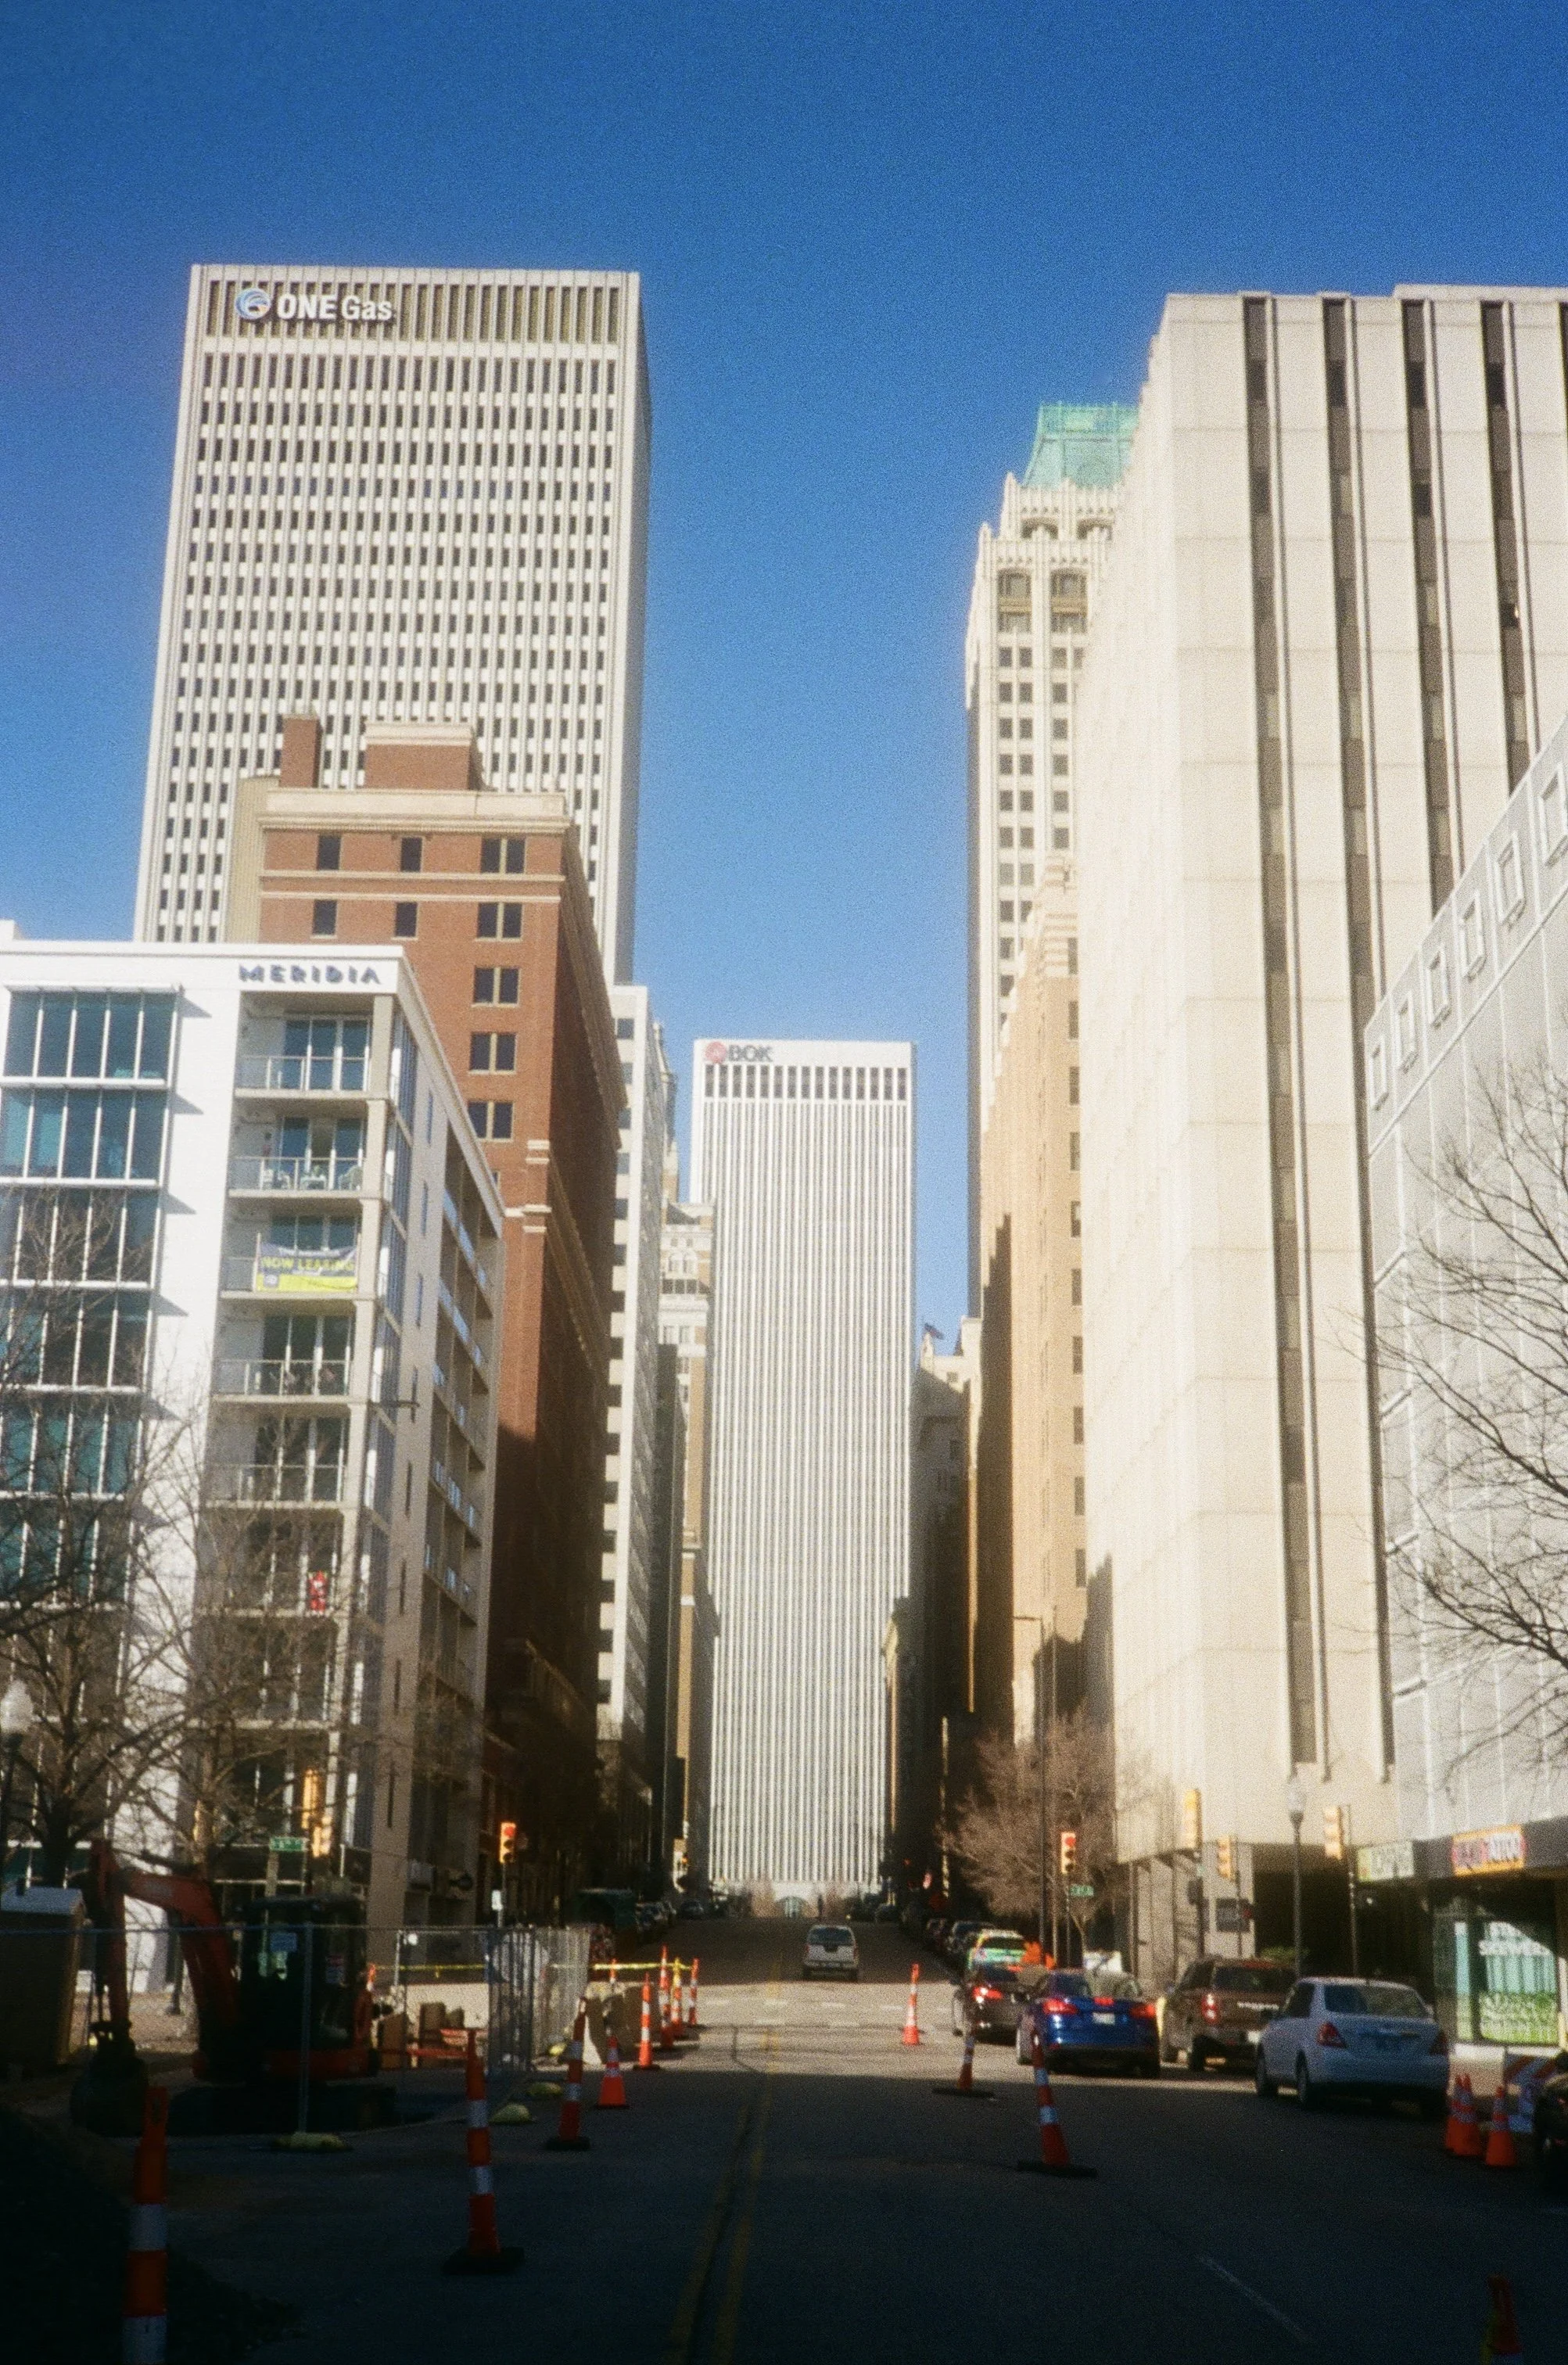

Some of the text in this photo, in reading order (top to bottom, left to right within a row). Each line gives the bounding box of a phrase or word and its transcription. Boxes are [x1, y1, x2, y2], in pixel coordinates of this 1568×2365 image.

[277, 293, 391, 321] ONE Gas
[239, 964, 382, 985] MERIDIA
[727, 1044, 773, 1062] BOK
[261, 1257, 294, 1269] NOW
